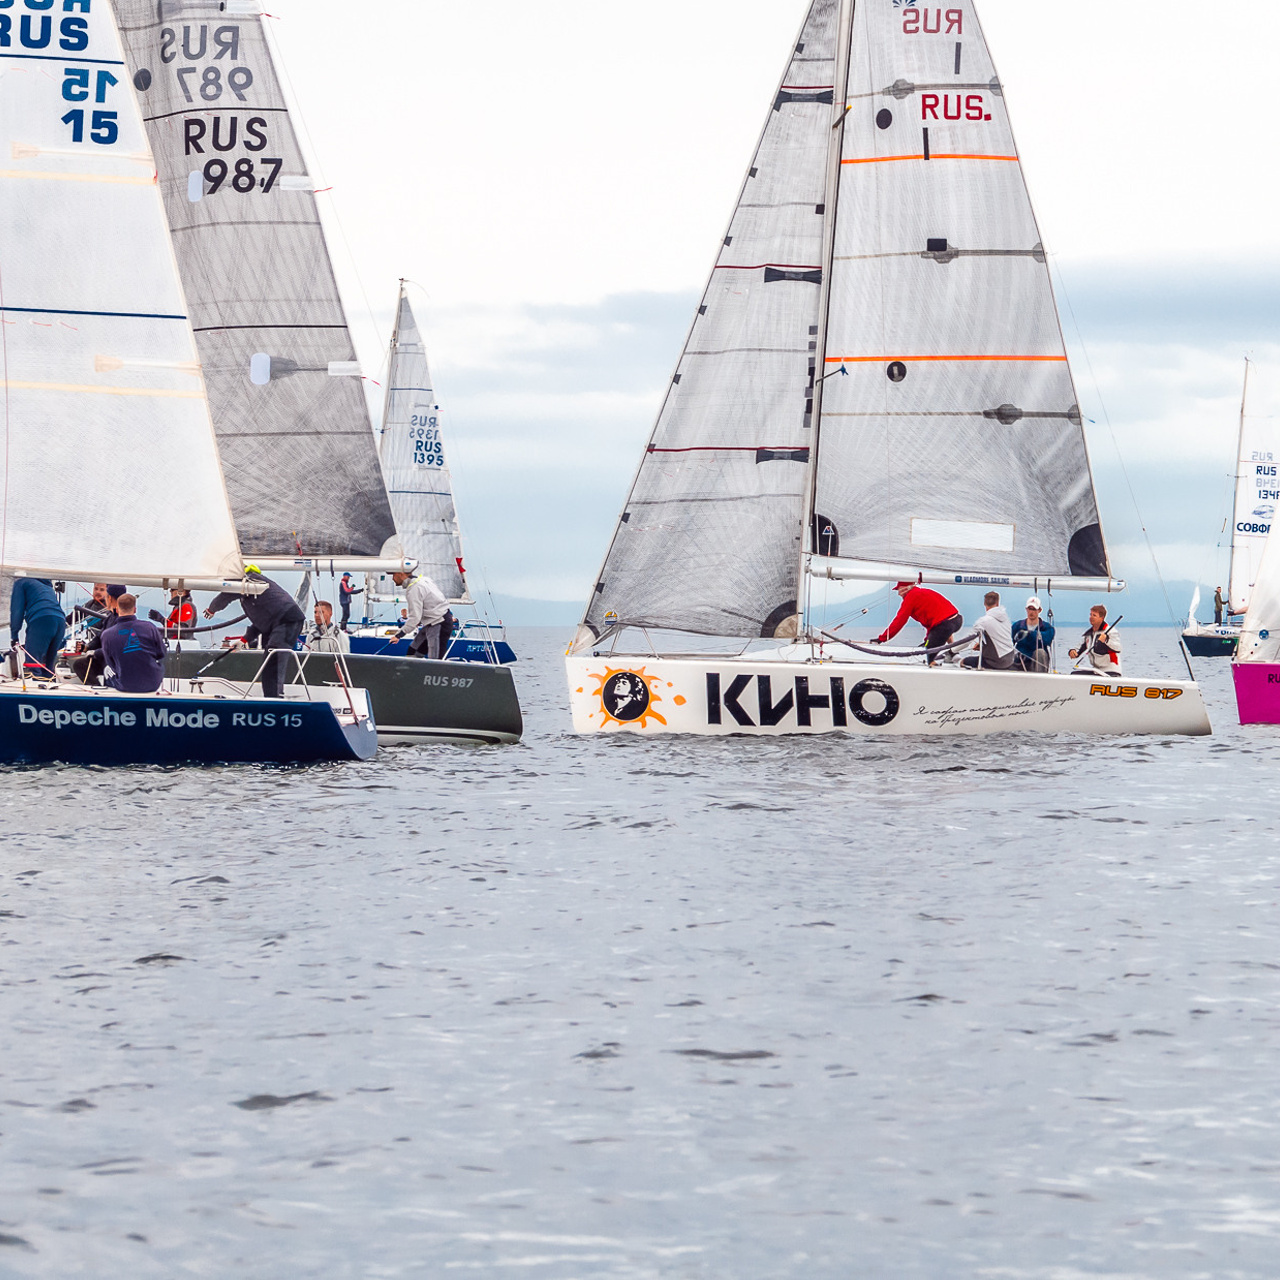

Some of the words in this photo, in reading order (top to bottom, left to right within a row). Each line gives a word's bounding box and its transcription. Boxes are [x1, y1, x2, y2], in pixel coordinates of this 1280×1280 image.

[60, 109, 119, 145] 15
[184, 117, 268, 155] RUS
[203, 158, 283, 195] 987
[416, 440, 442, 453] RUS
[413, 452, 444, 466] 1395
[1256, 466, 1277, 476] RUS
[424, 675, 449, 688] RUS
[451, 677, 474, 689] 987
[706, 672, 900, 727] КИНО
[1090, 684, 1138, 698] RUS
[1144, 687, 1183, 700] 817
[18, 704, 137, 729] Depeche
[146, 707, 220, 729] Mode
[232, 713, 276, 727] RUS
[280, 713, 303, 728] 15
[913, 705, 929, 716] Я
